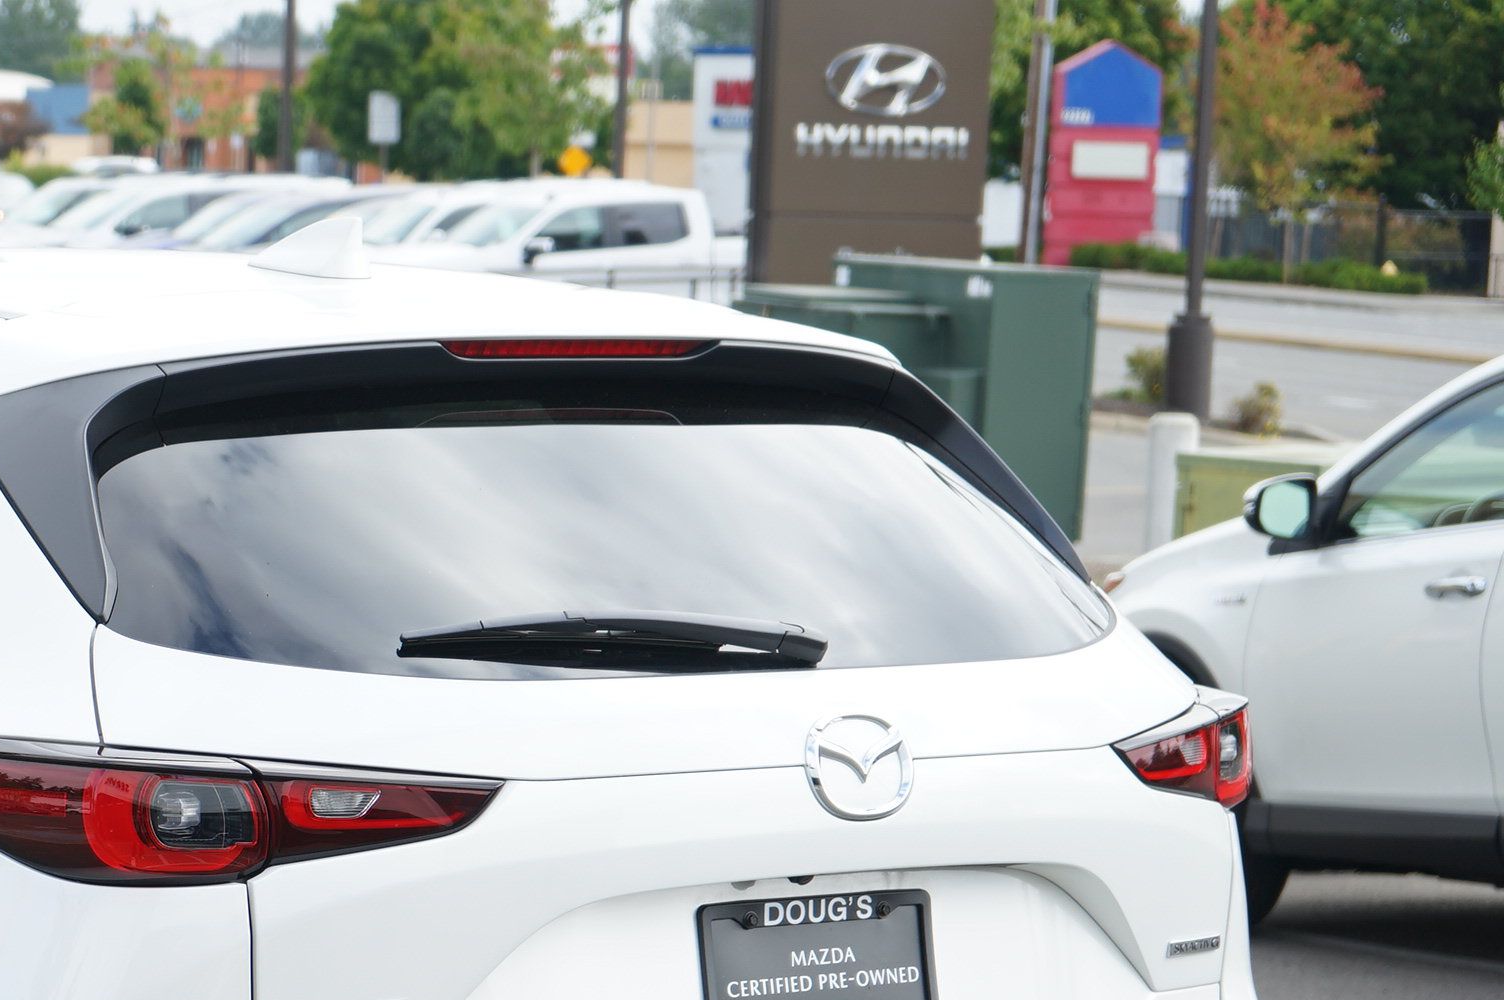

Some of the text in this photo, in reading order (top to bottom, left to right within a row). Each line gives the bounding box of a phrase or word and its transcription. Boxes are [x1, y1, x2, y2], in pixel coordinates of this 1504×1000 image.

[795, 122, 969, 158] HYUNDAI
[763, 895, 873, 927] DOUG'S
[791, 947, 856, 967] MAZDA
[727, 966, 920, 998] CERTIFIED PRE-OWNED
